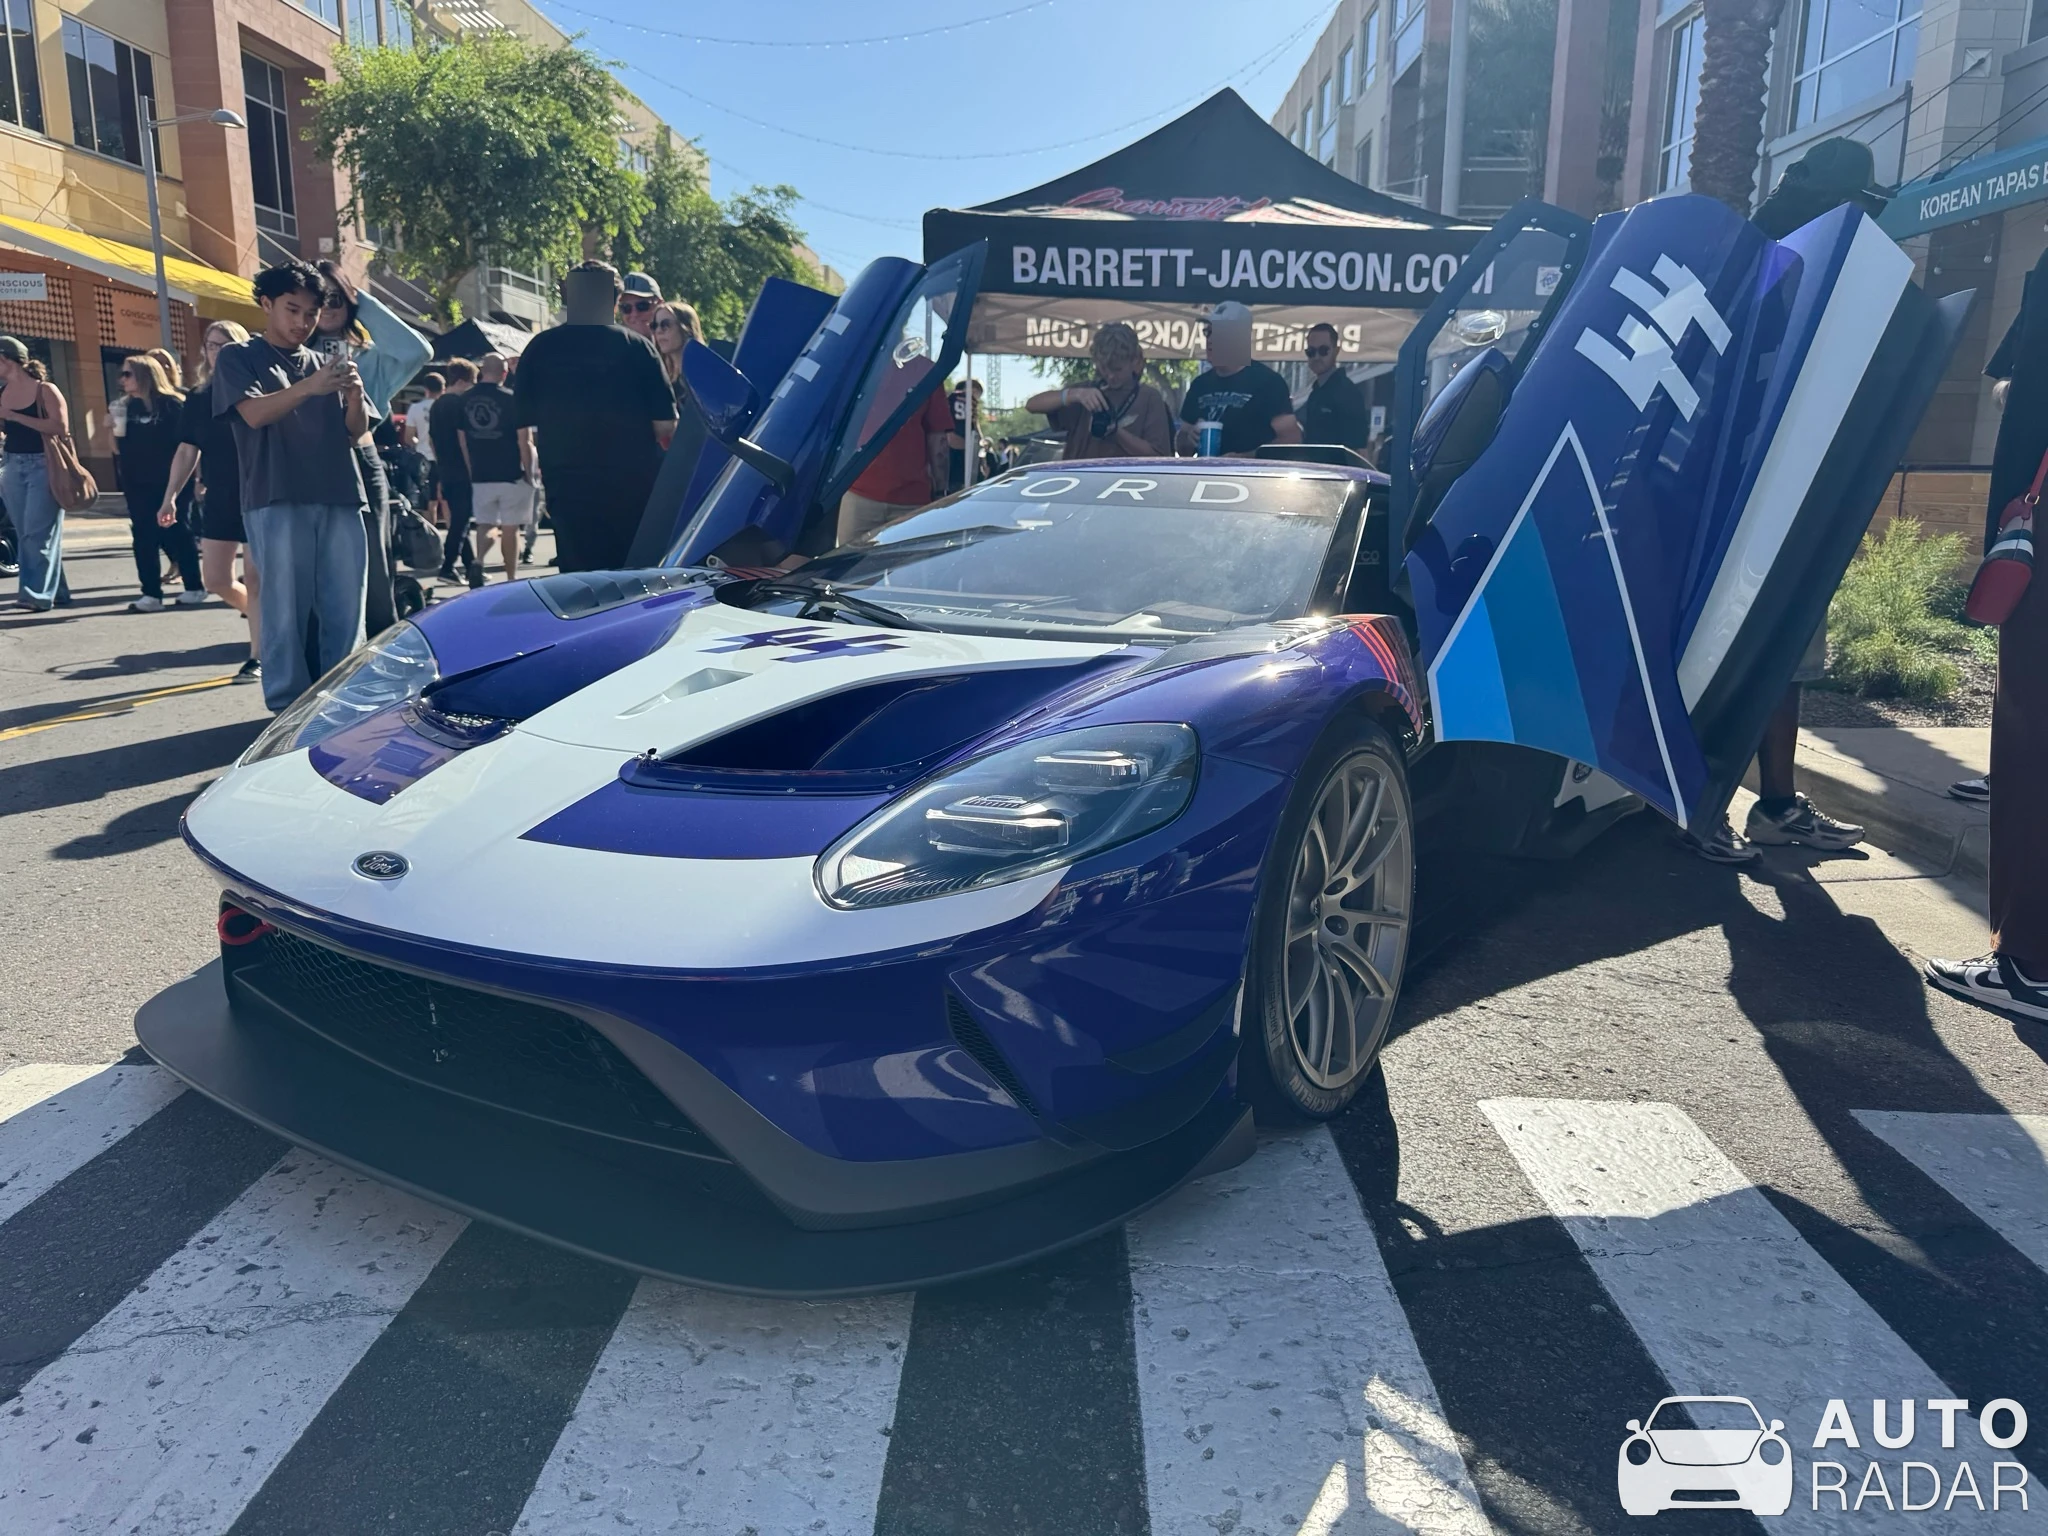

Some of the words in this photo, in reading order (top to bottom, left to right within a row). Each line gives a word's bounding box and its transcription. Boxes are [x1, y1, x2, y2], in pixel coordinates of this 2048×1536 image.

[1920, 182, 1982, 220] KOREAN
[1986, 164, 2040, 200] TAPAS
[1574, 253, 1733, 423] 44
